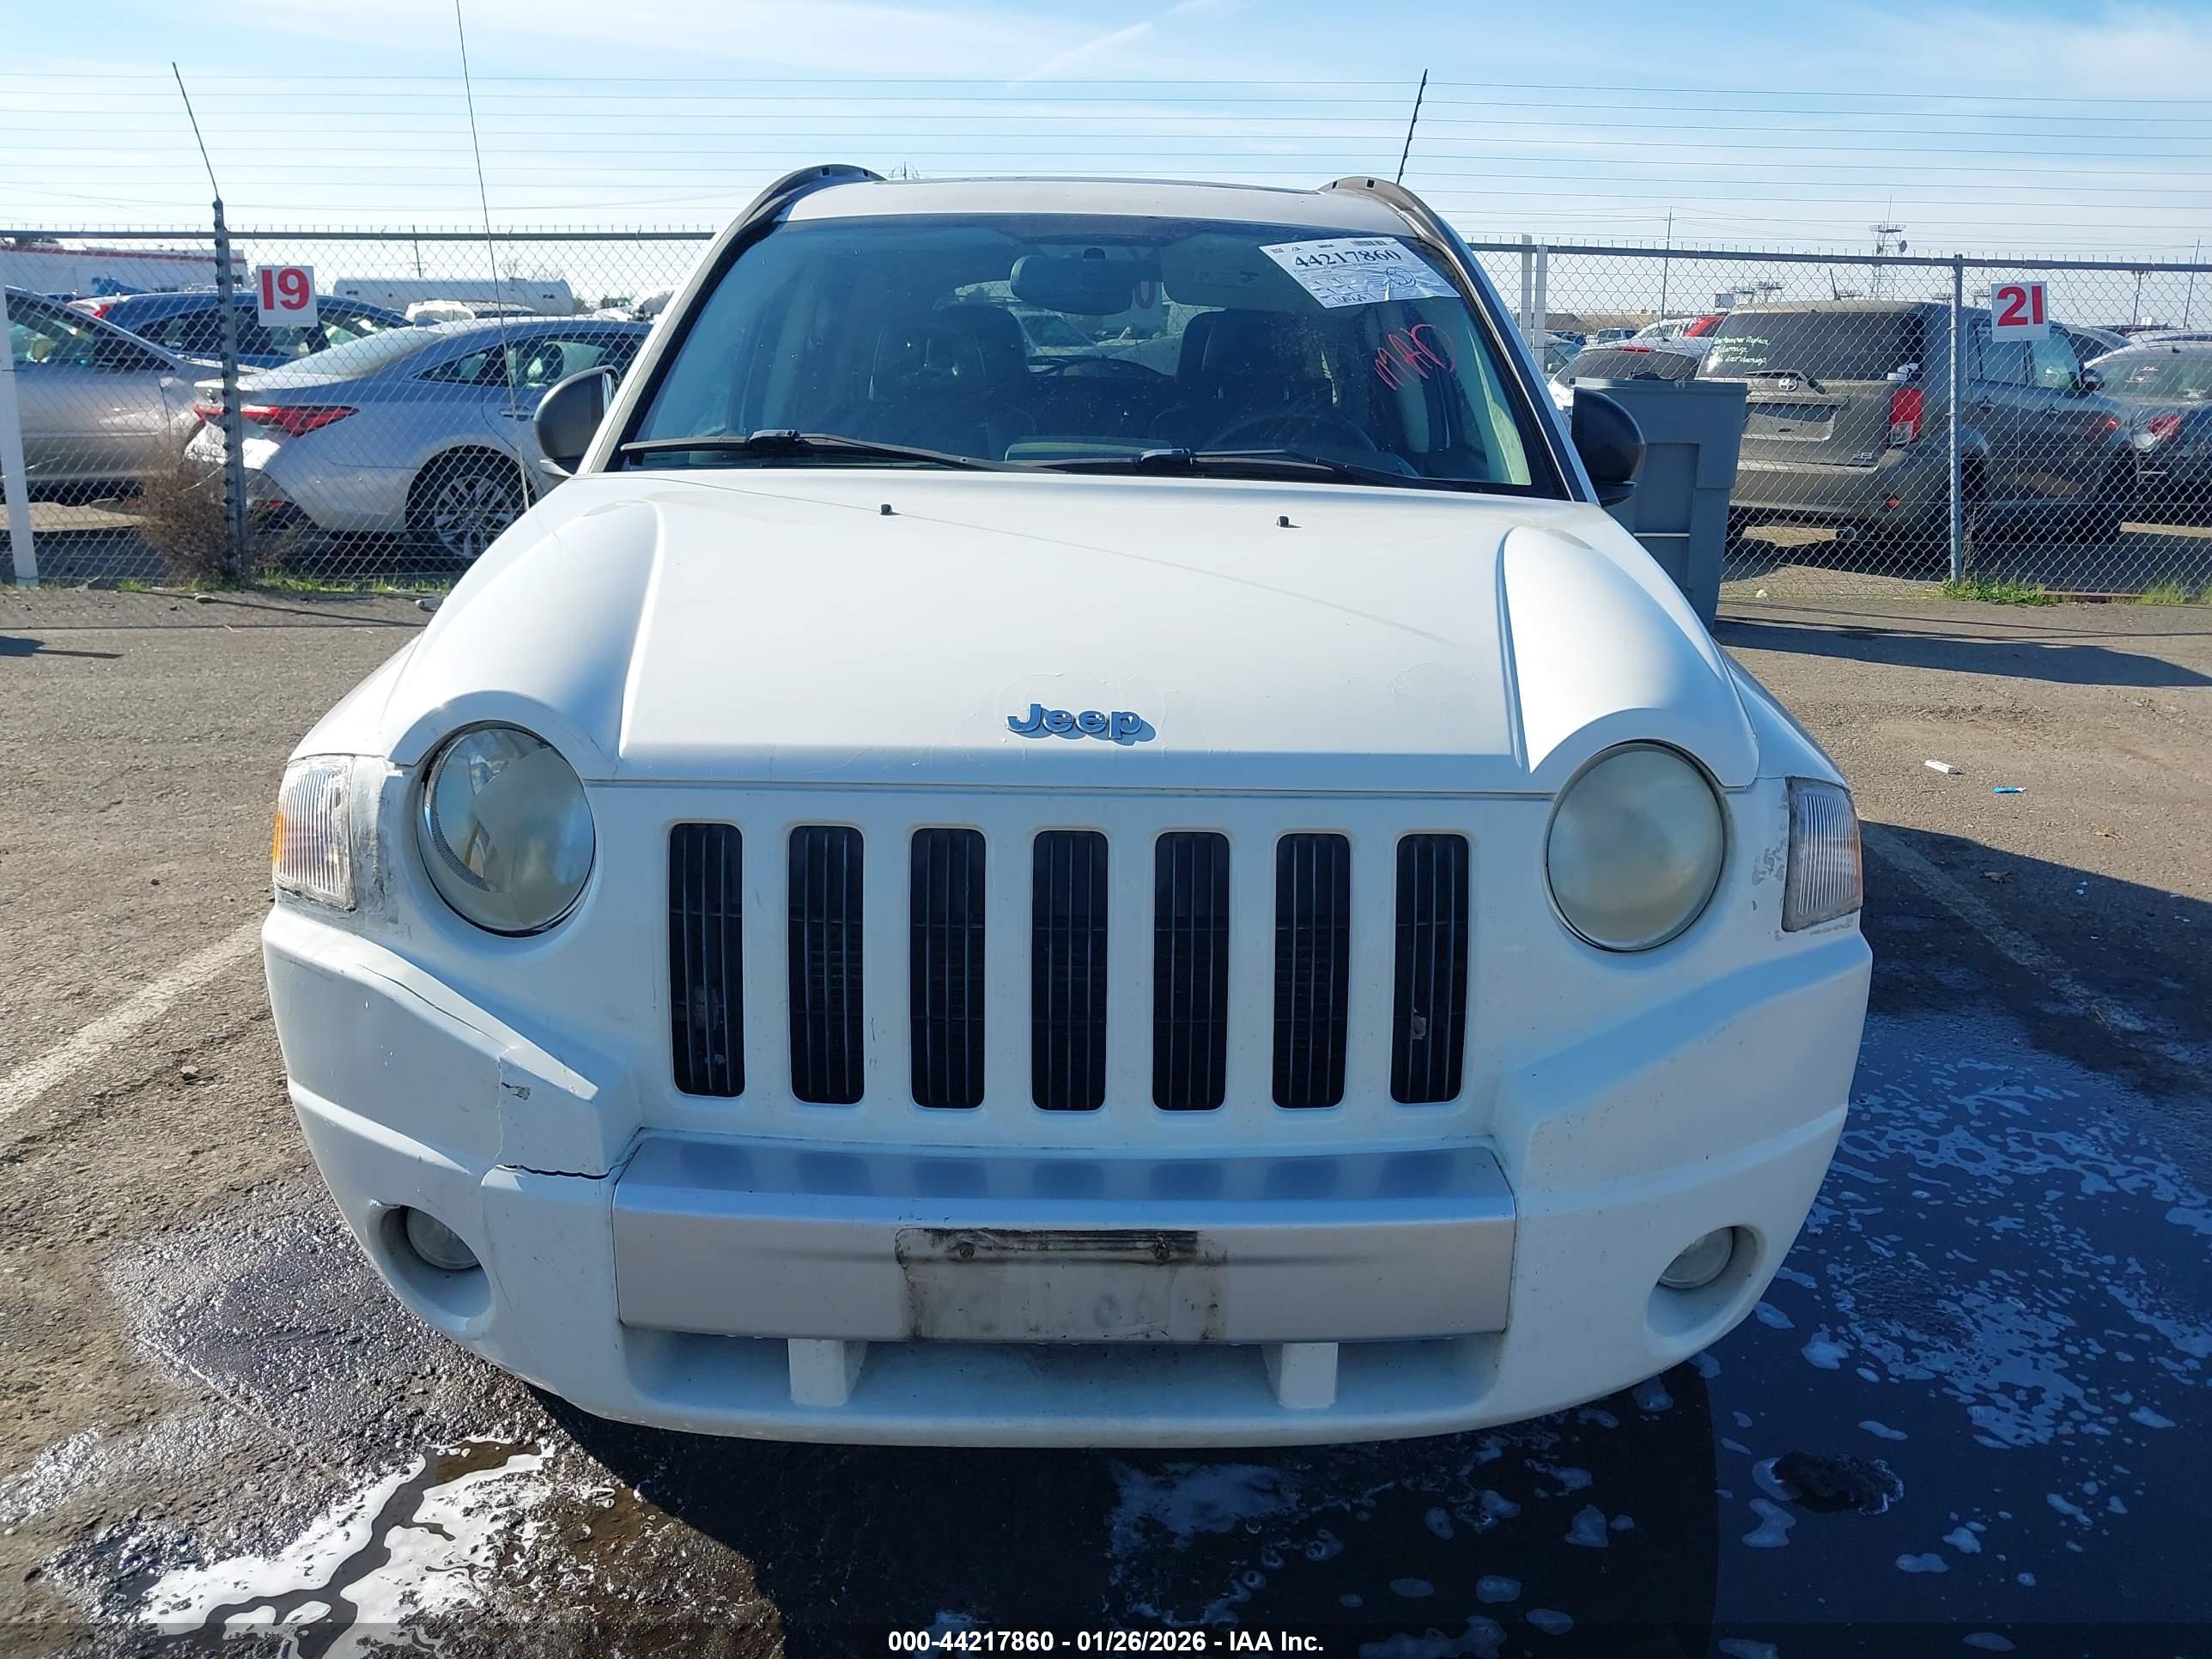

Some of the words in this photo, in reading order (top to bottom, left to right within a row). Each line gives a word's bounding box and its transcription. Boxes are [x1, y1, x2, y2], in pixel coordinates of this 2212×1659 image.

[1295, 249, 1402, 267] 44217860
[261, 268, 310, 311] 19
[1997, 285, 2044, 326] 21
[1006, 703, 1143, 740] Jeep
